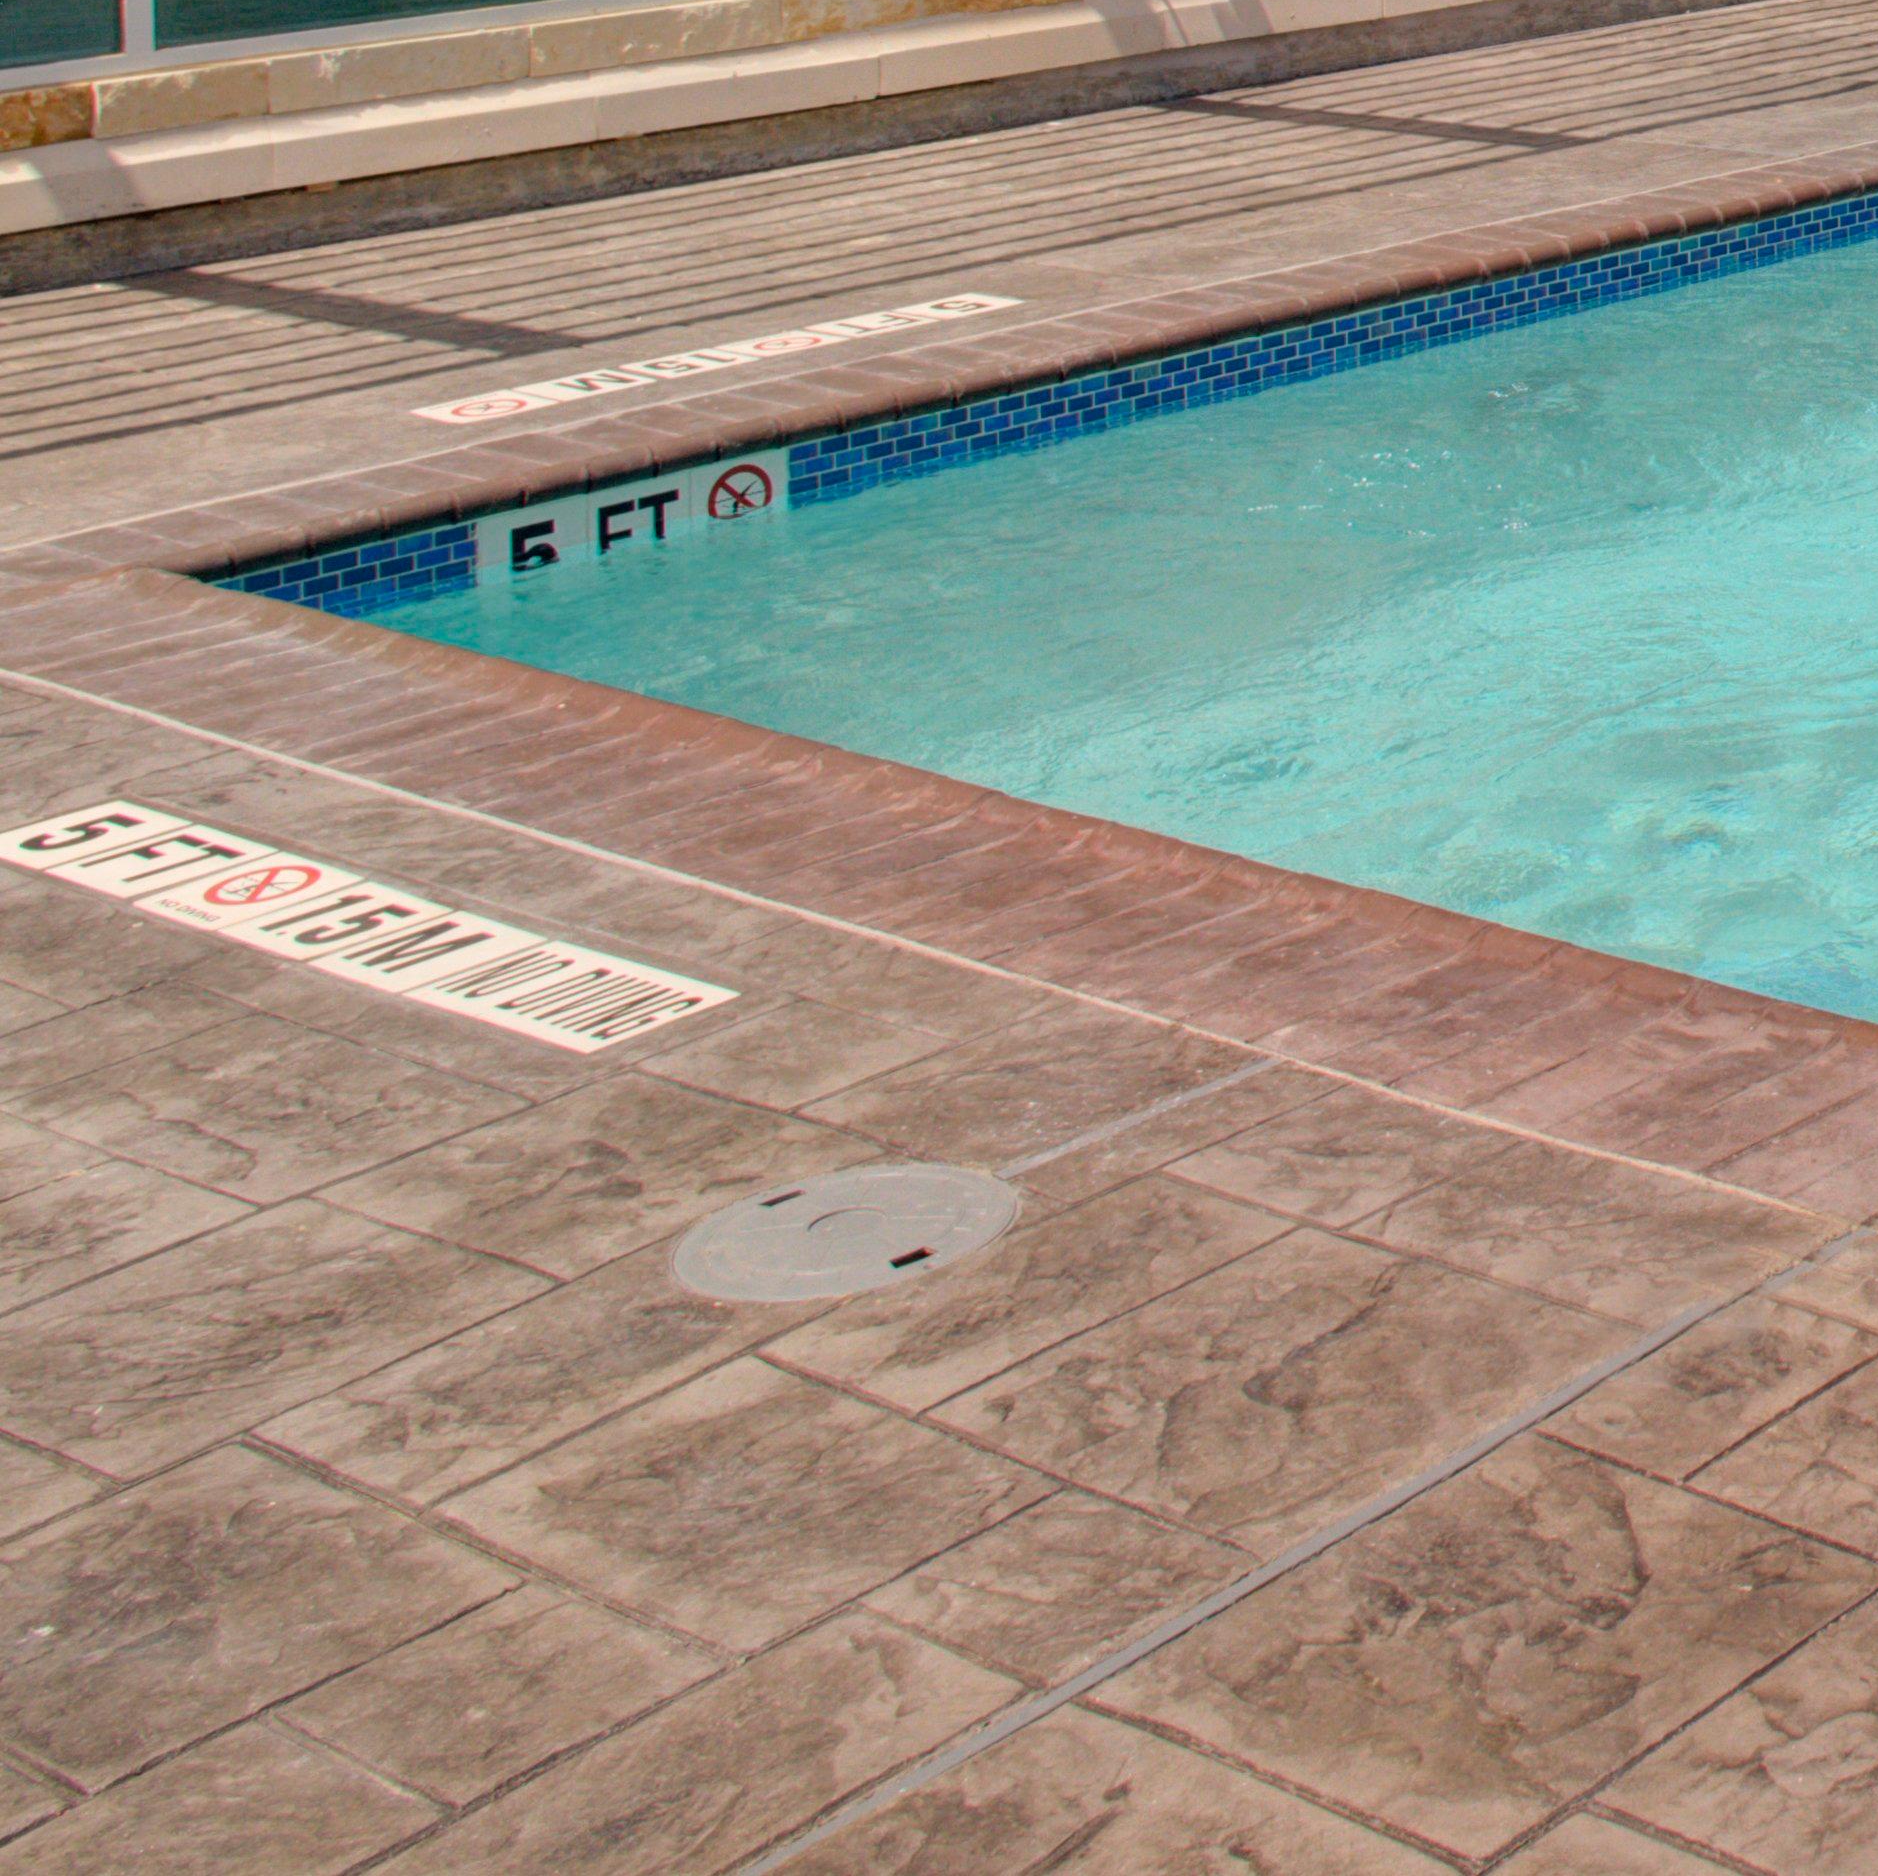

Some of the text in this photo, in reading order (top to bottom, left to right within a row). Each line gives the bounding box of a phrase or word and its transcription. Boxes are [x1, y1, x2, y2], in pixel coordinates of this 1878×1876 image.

[835, 311, 919, 334] FT
[929, 300, 995, 314] 5
[551, 373, 640, 392] M
[511, 488, 680, 572] 5 FT
[19, 813, 146, 851] 5
[80, 834, 247, 883] FT
[342, 920, 496, 973] M
[433, 951, 575, 998] NO
[494, 968, 704, 1040] DIVING
